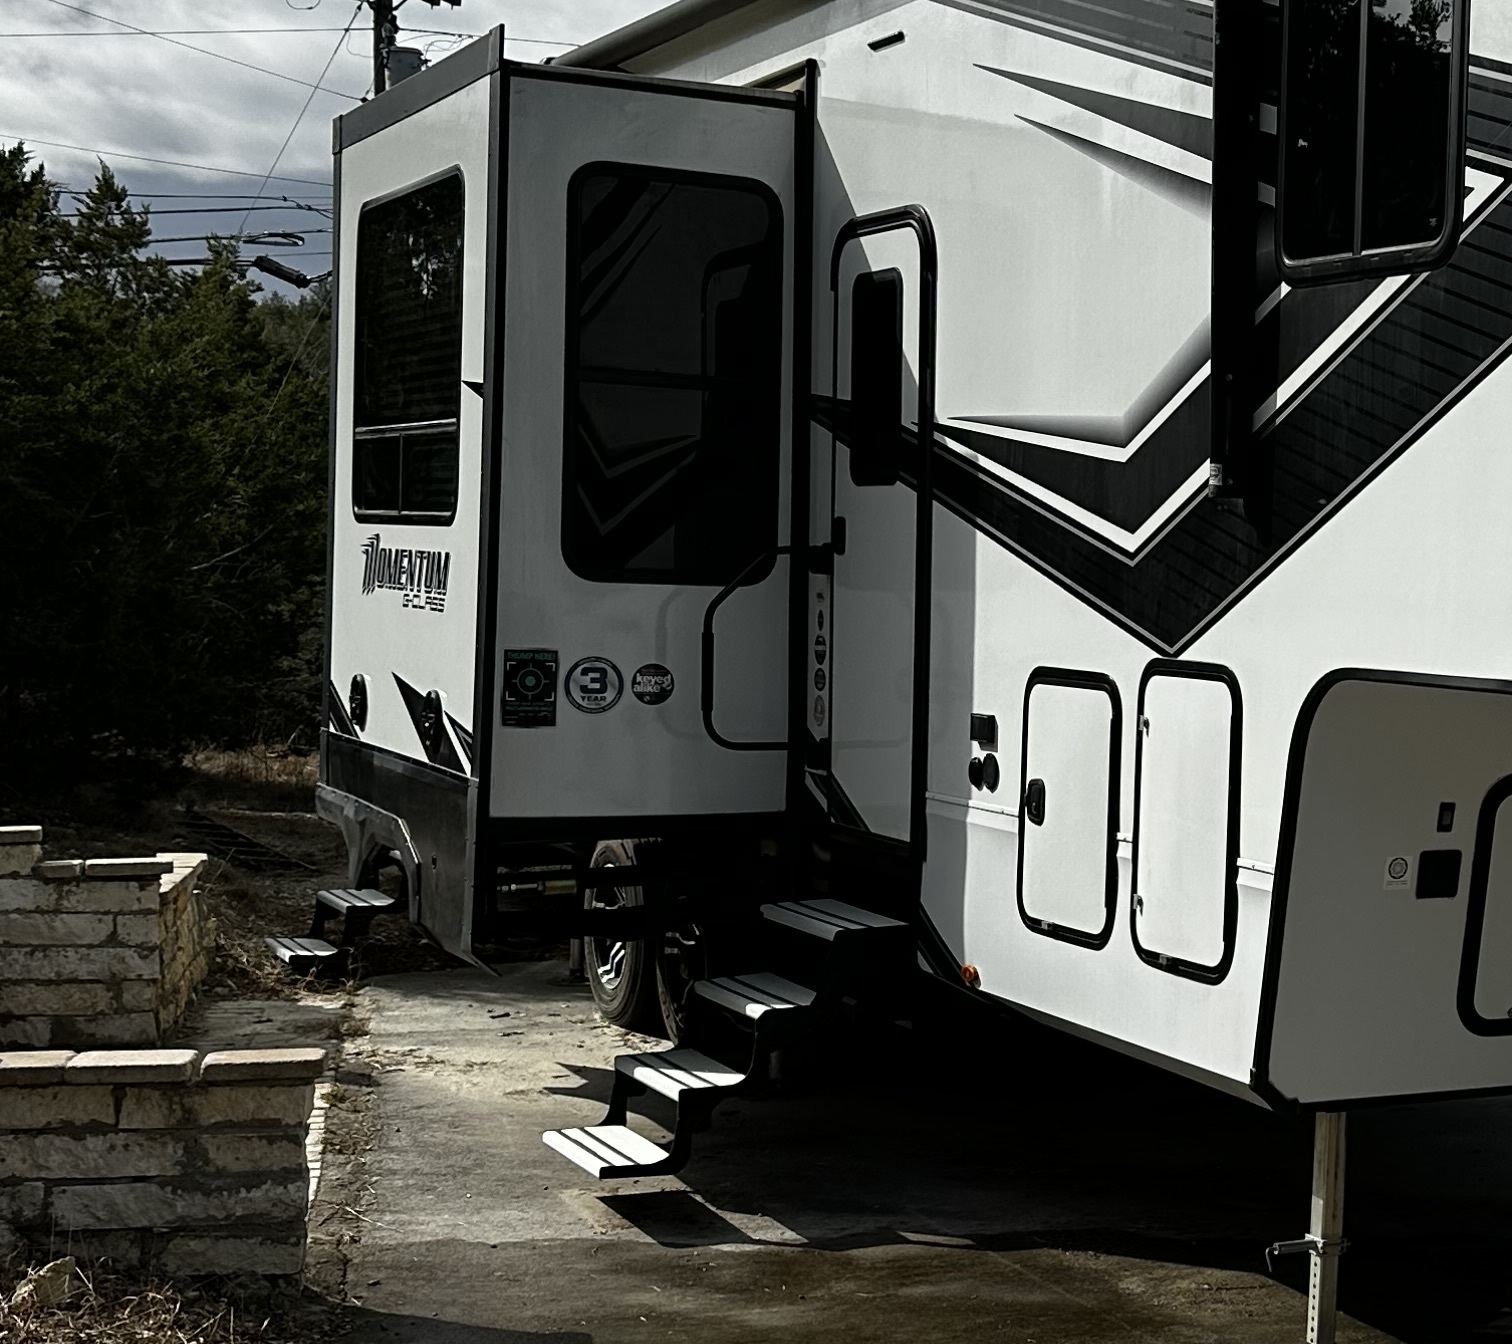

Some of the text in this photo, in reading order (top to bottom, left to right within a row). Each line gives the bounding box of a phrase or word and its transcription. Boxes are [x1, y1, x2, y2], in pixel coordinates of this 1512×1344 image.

[360, 533, 451, 596] MOMENTUM
[402, 594, 445, 613] G-CLASS
[580, 667, 607, 695] 3
[633, 682, 661, 693] alike
[636, 673, 671, 688] keyed
[580, 695, 607, 703] YEAR
